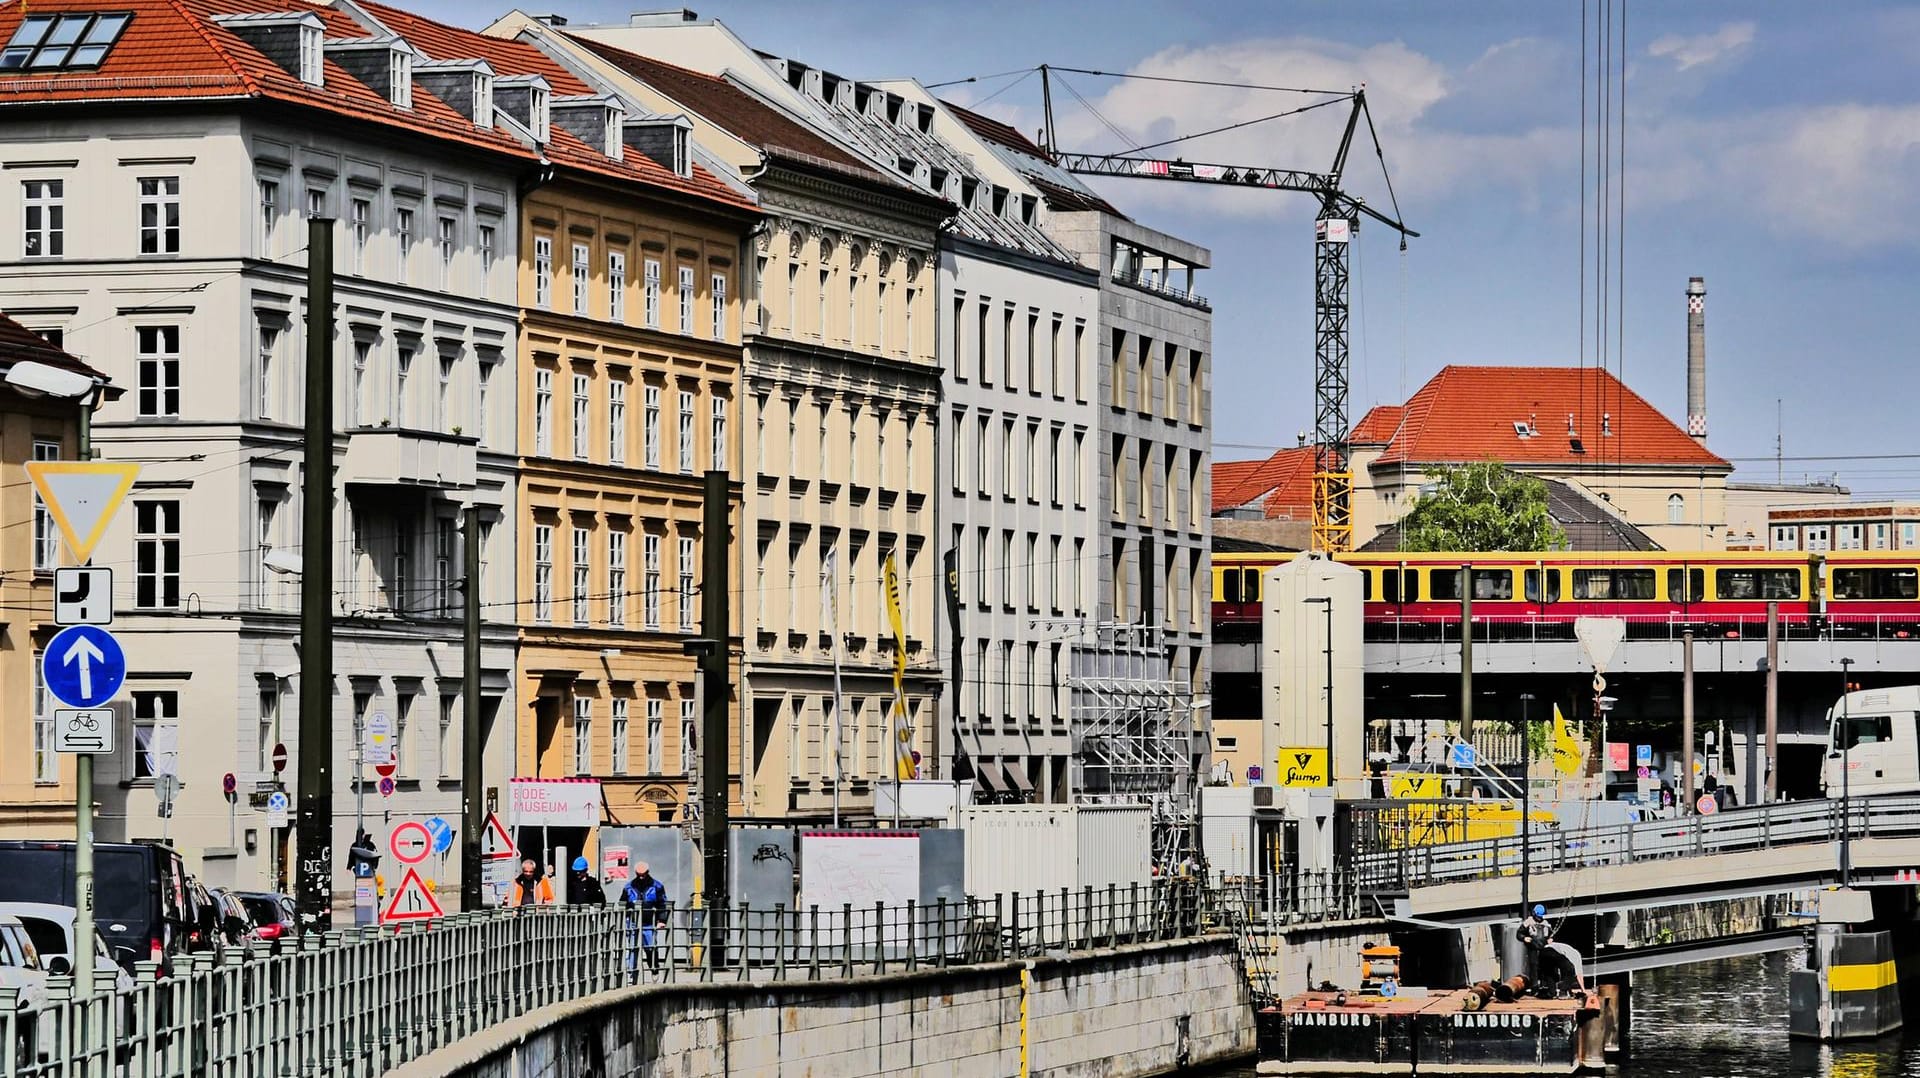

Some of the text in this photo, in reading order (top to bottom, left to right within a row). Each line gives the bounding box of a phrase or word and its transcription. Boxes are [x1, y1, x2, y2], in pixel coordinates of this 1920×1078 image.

[1285, 767, 1320, 785] Stump
[514, 788, 551, 800] BODE-
[514, 802, 567, 812] MUSEUM
[360, 862, 369, 876] P
[1294, 1013, 1371, 1026] HAMBURG
[1454, 1014, 1531, 1028] HAMBURG
